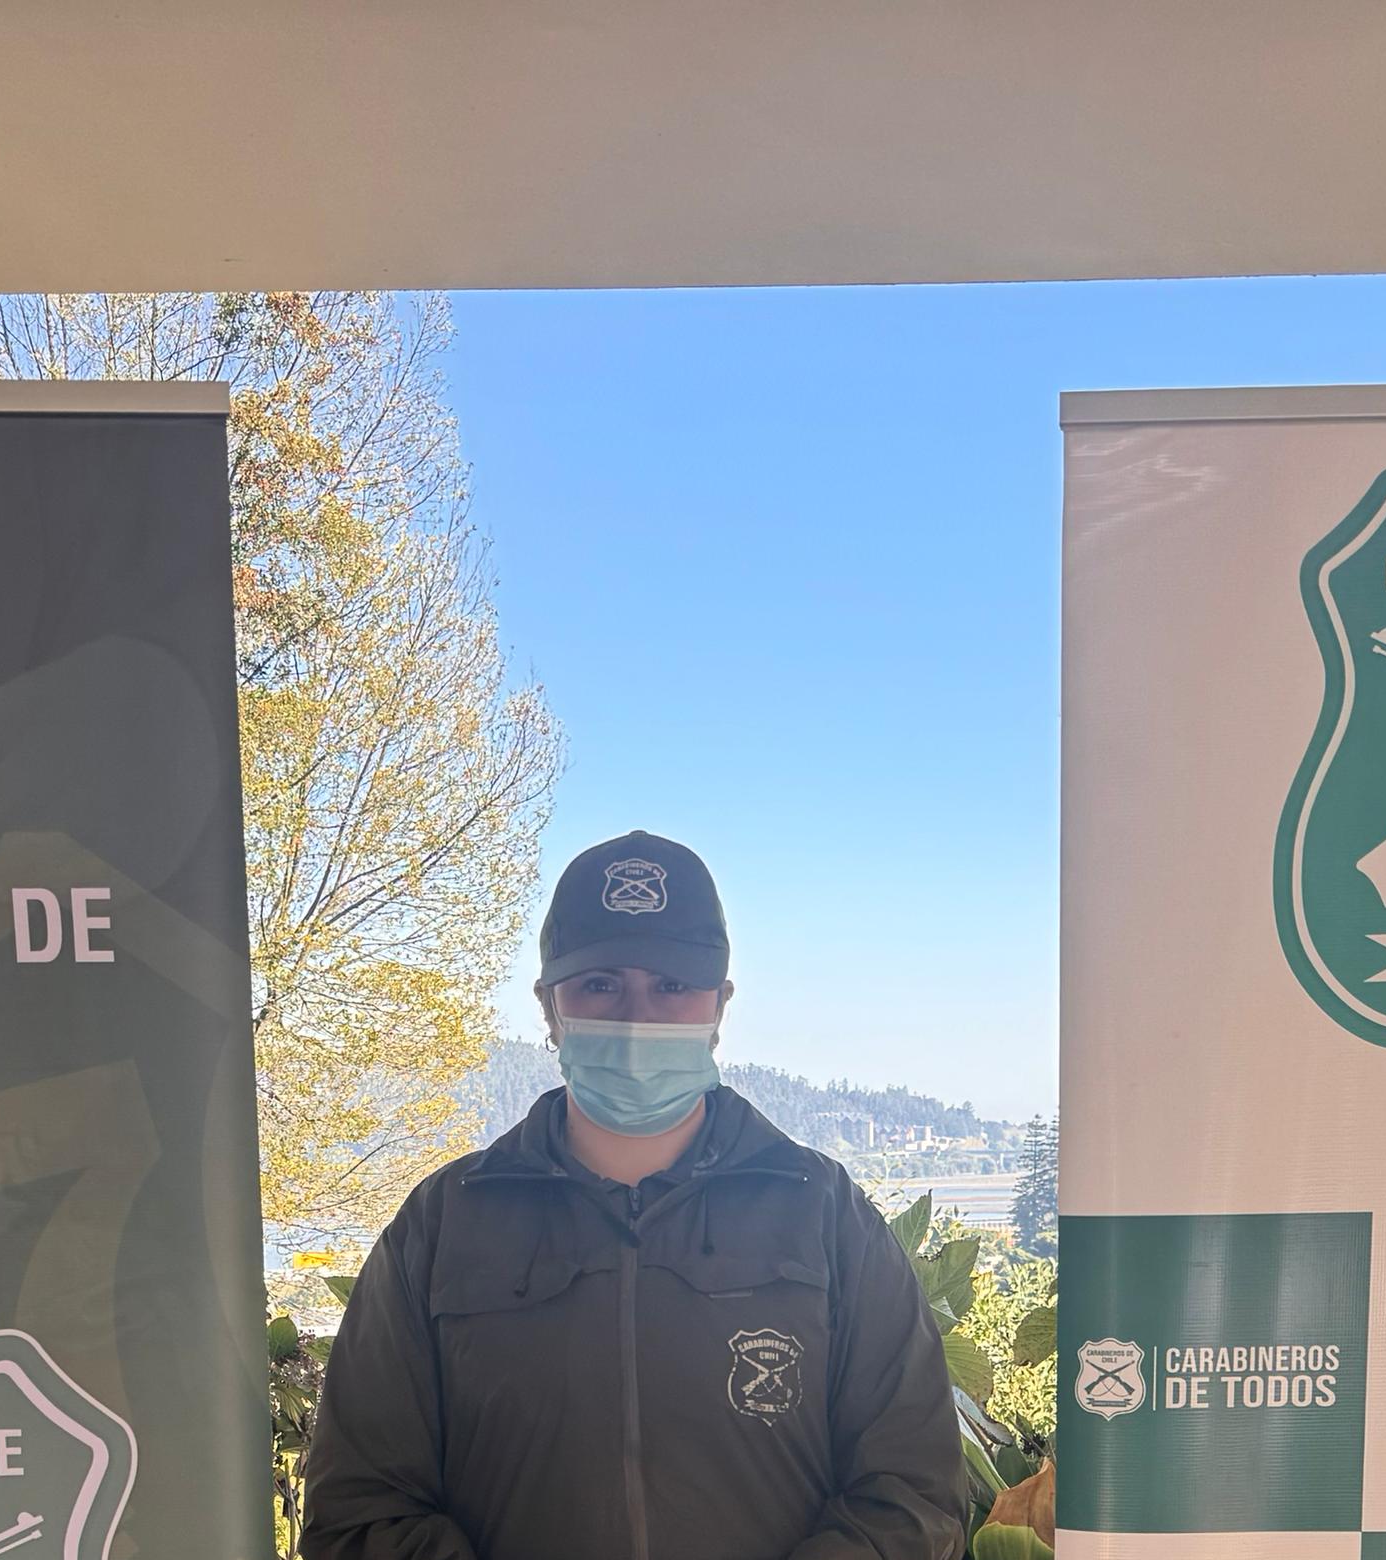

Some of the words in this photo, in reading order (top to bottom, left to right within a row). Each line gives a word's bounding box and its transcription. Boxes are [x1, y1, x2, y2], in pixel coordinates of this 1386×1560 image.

[14, 887, 115, 964] DE
[1165, 1345, 1340, 1373] CARABINEROS
[1165, 1376, 1210, 1409] DE
[1220, 1374, 1337, 1408] TODOS
